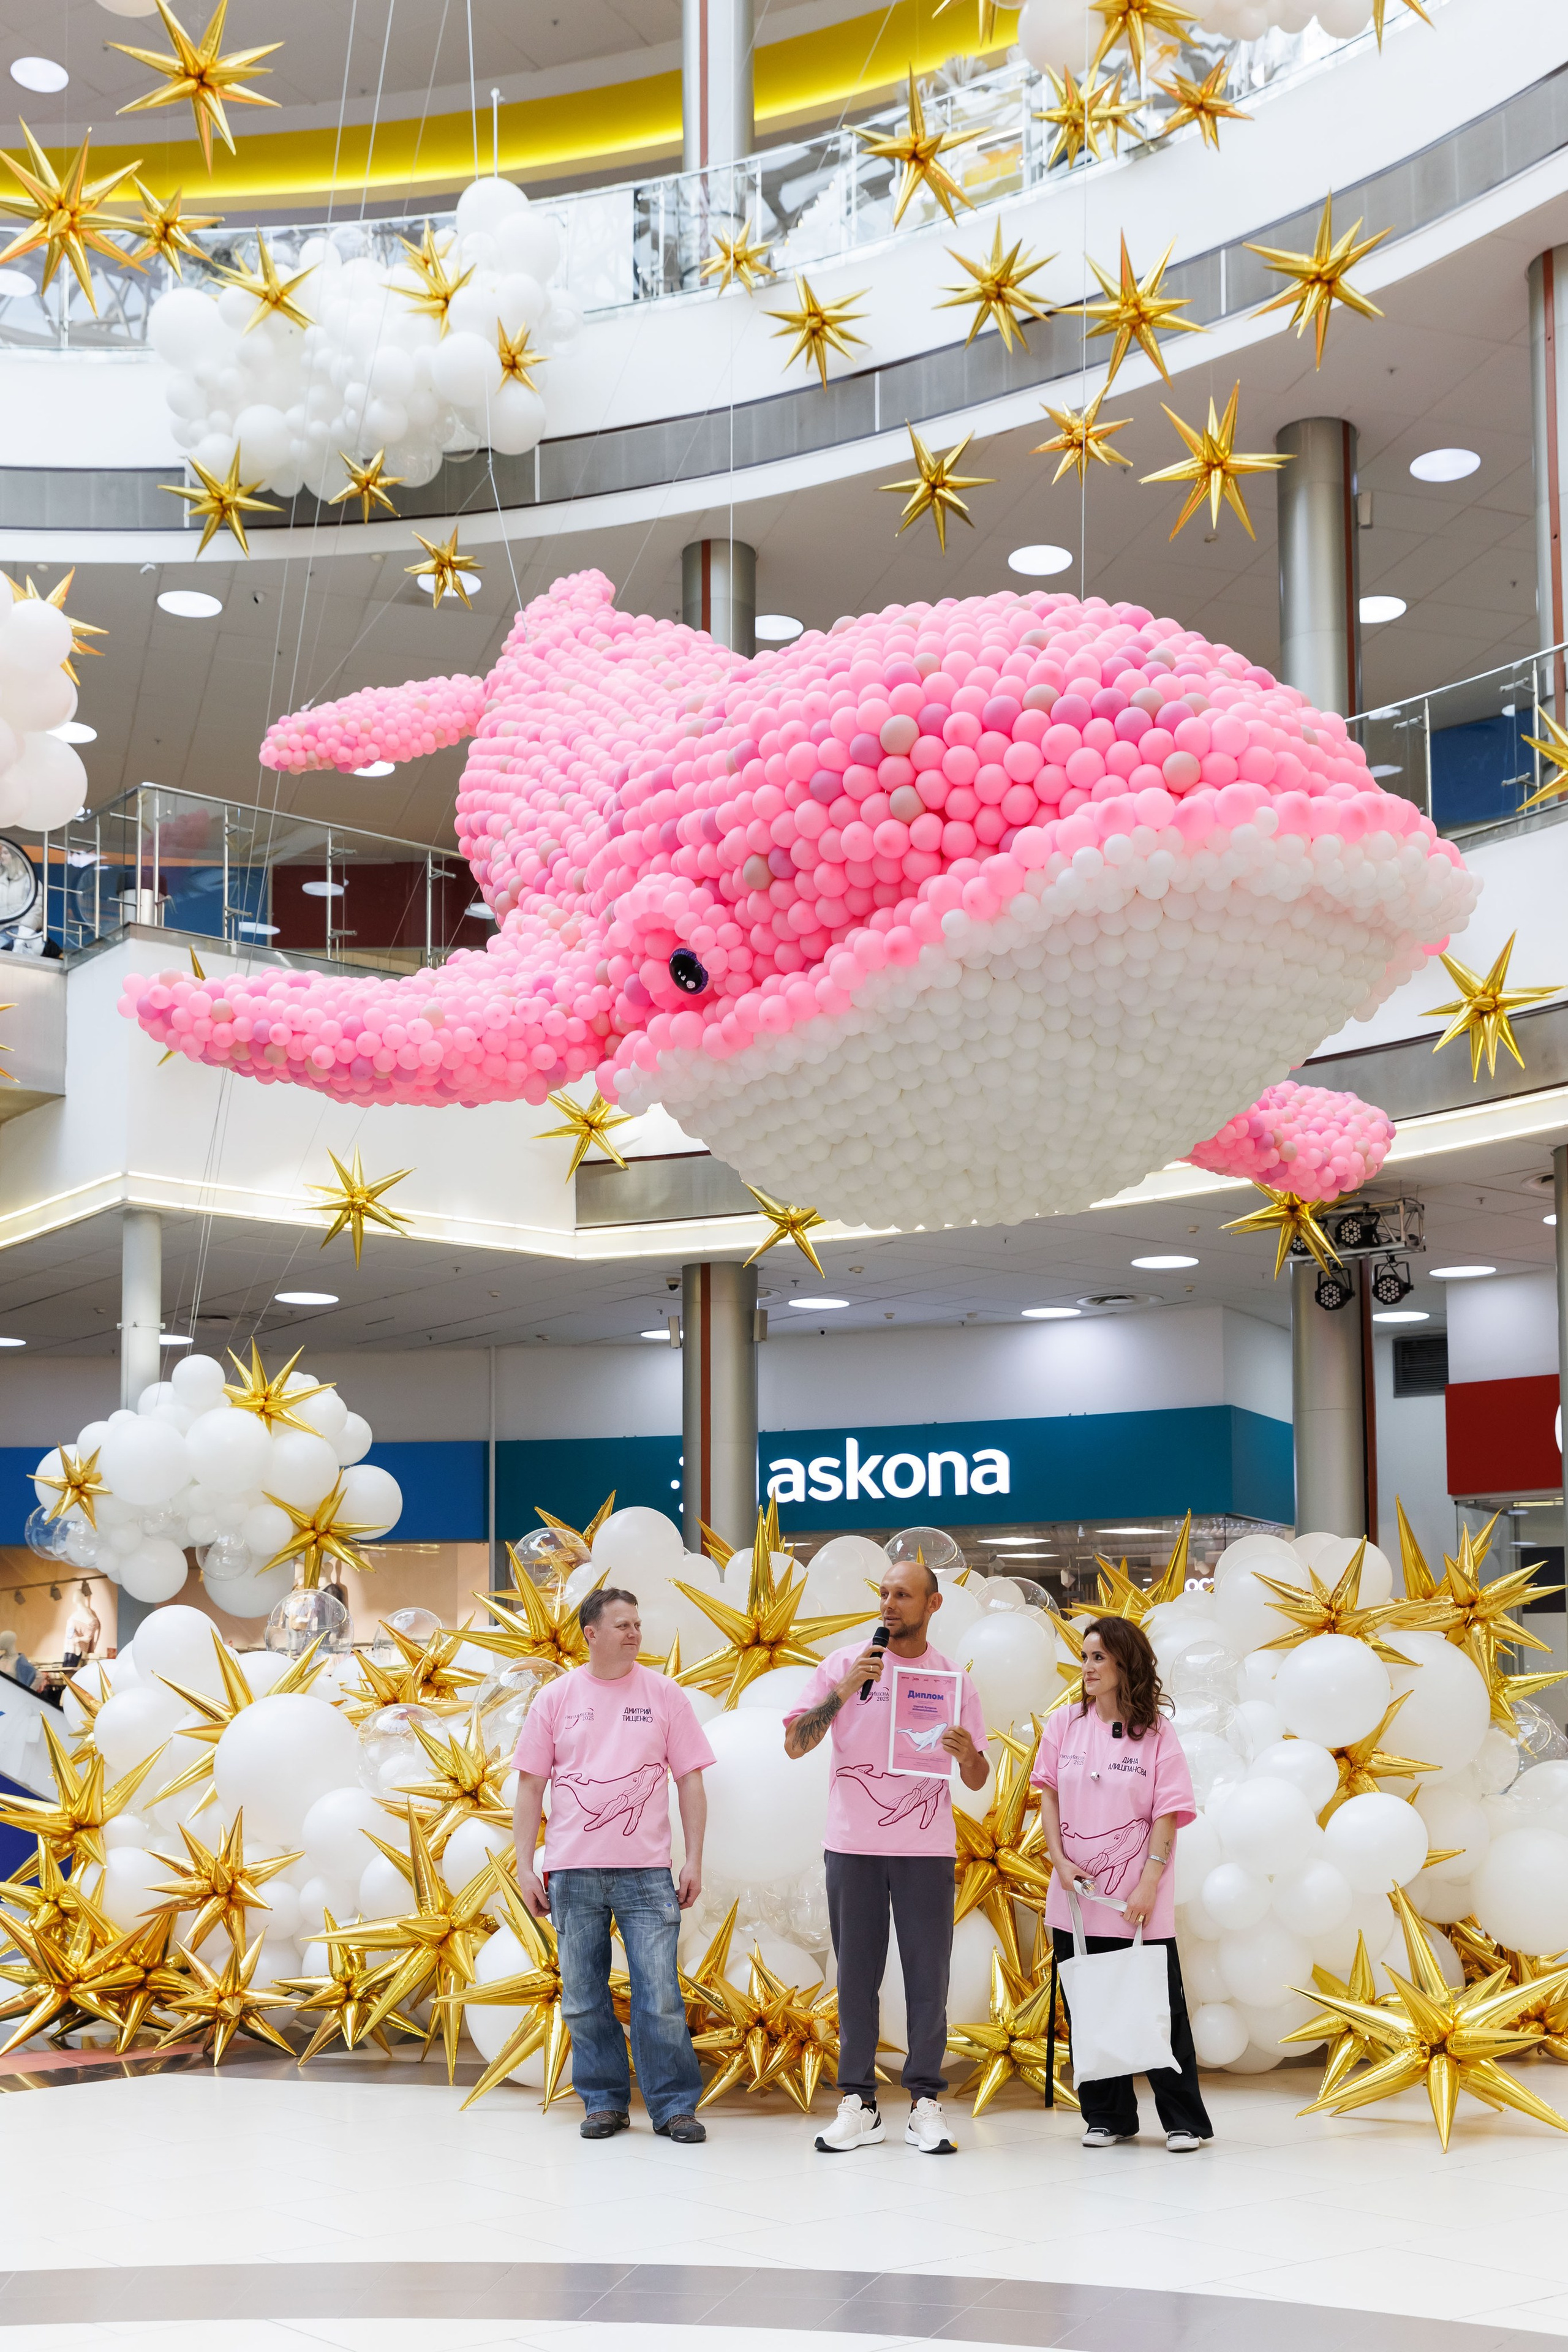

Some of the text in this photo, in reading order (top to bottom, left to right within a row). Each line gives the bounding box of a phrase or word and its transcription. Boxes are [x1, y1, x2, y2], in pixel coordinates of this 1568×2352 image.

[767, 1438, 1011, 1503] askona
[908, 1690, 944, 1700] Диплом
[622, 1714, 653, 1723] ТИЩЕНКО
[1107, 1763, 1147, 1777] АЛИШПАНОВА
